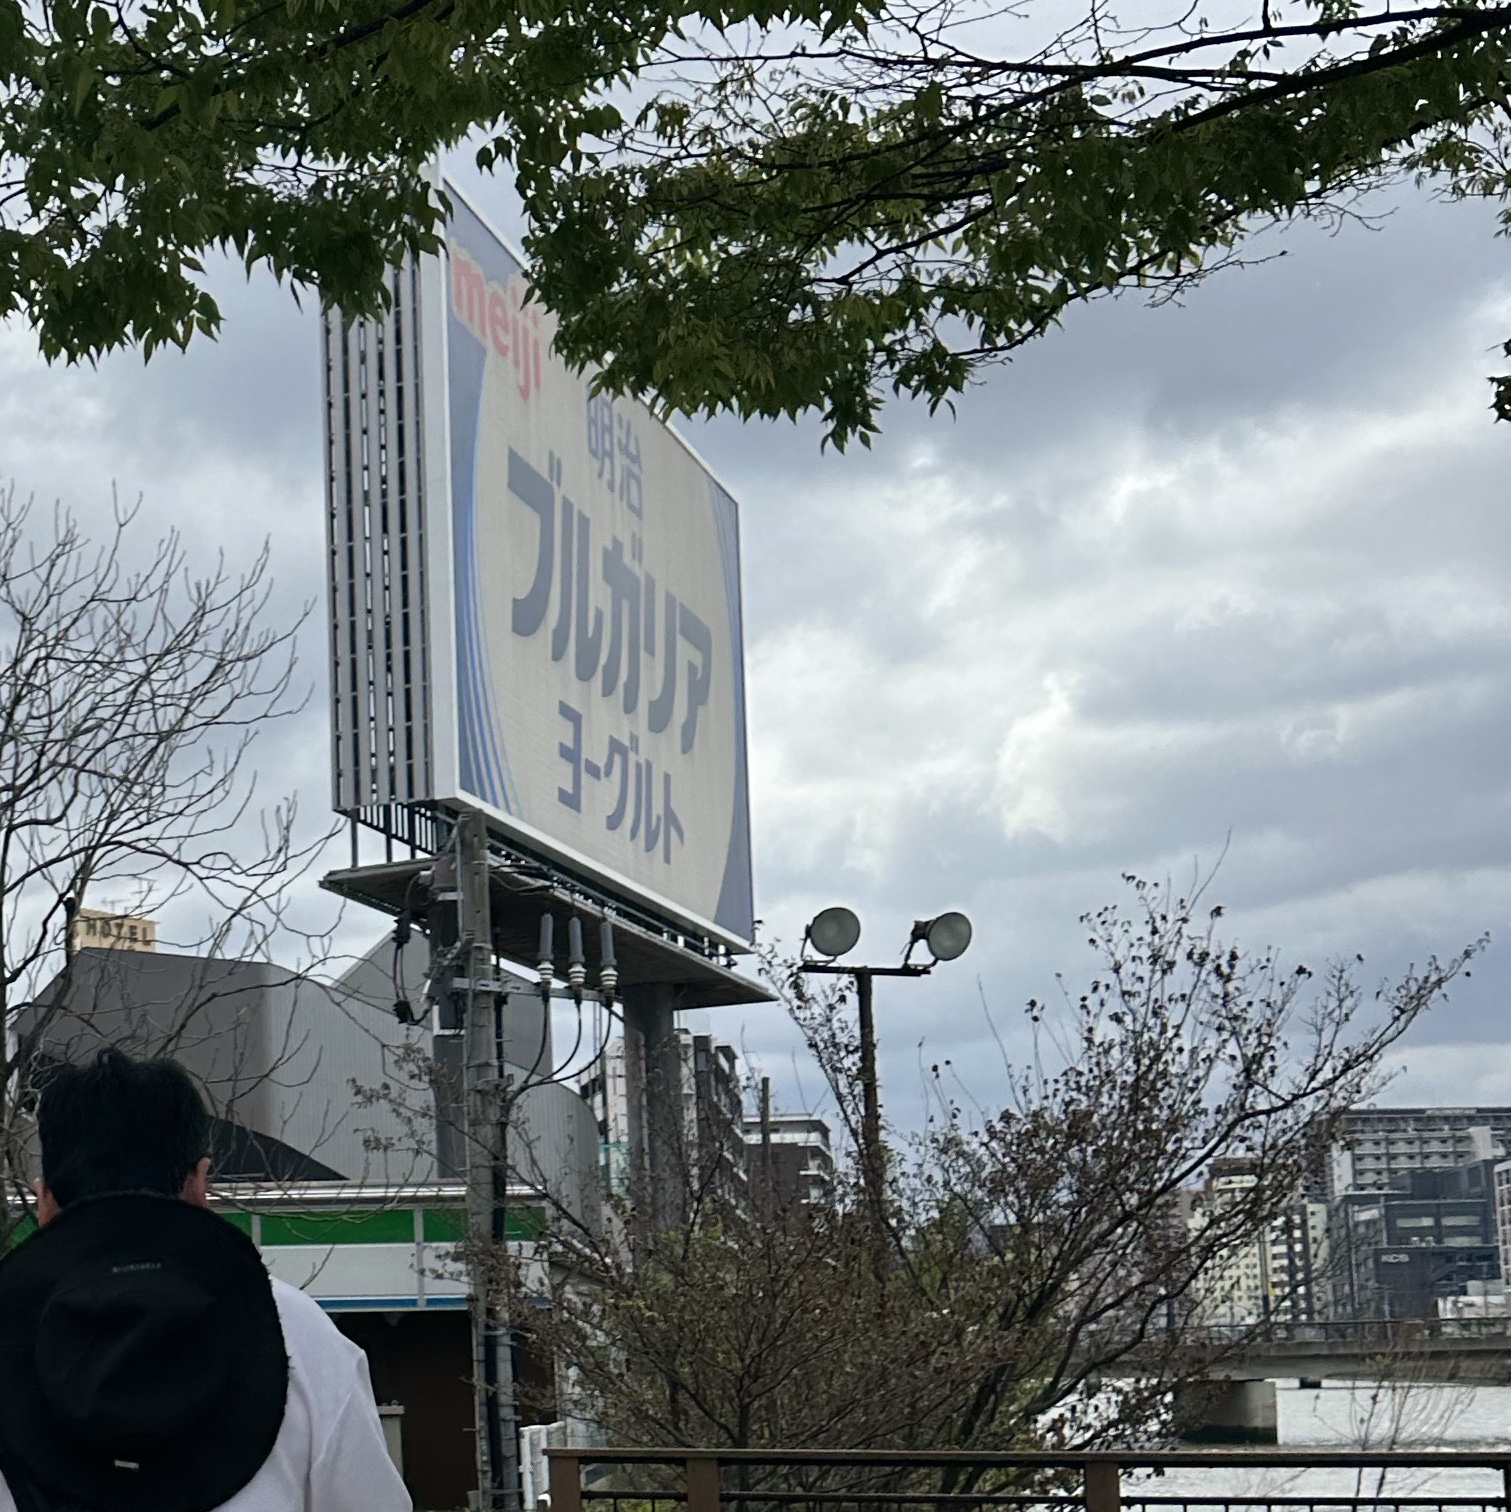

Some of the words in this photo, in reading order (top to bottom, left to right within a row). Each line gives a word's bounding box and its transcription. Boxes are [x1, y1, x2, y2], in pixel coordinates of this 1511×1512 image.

[453, 253, 541, 401] meiji
[587, 385, 643, 521] 明治
[507, 446, 712, 754] ブルガリア
[558, 699, 684, 865] ヨーグルト
[86, 920, 151, 945] HOTEL
